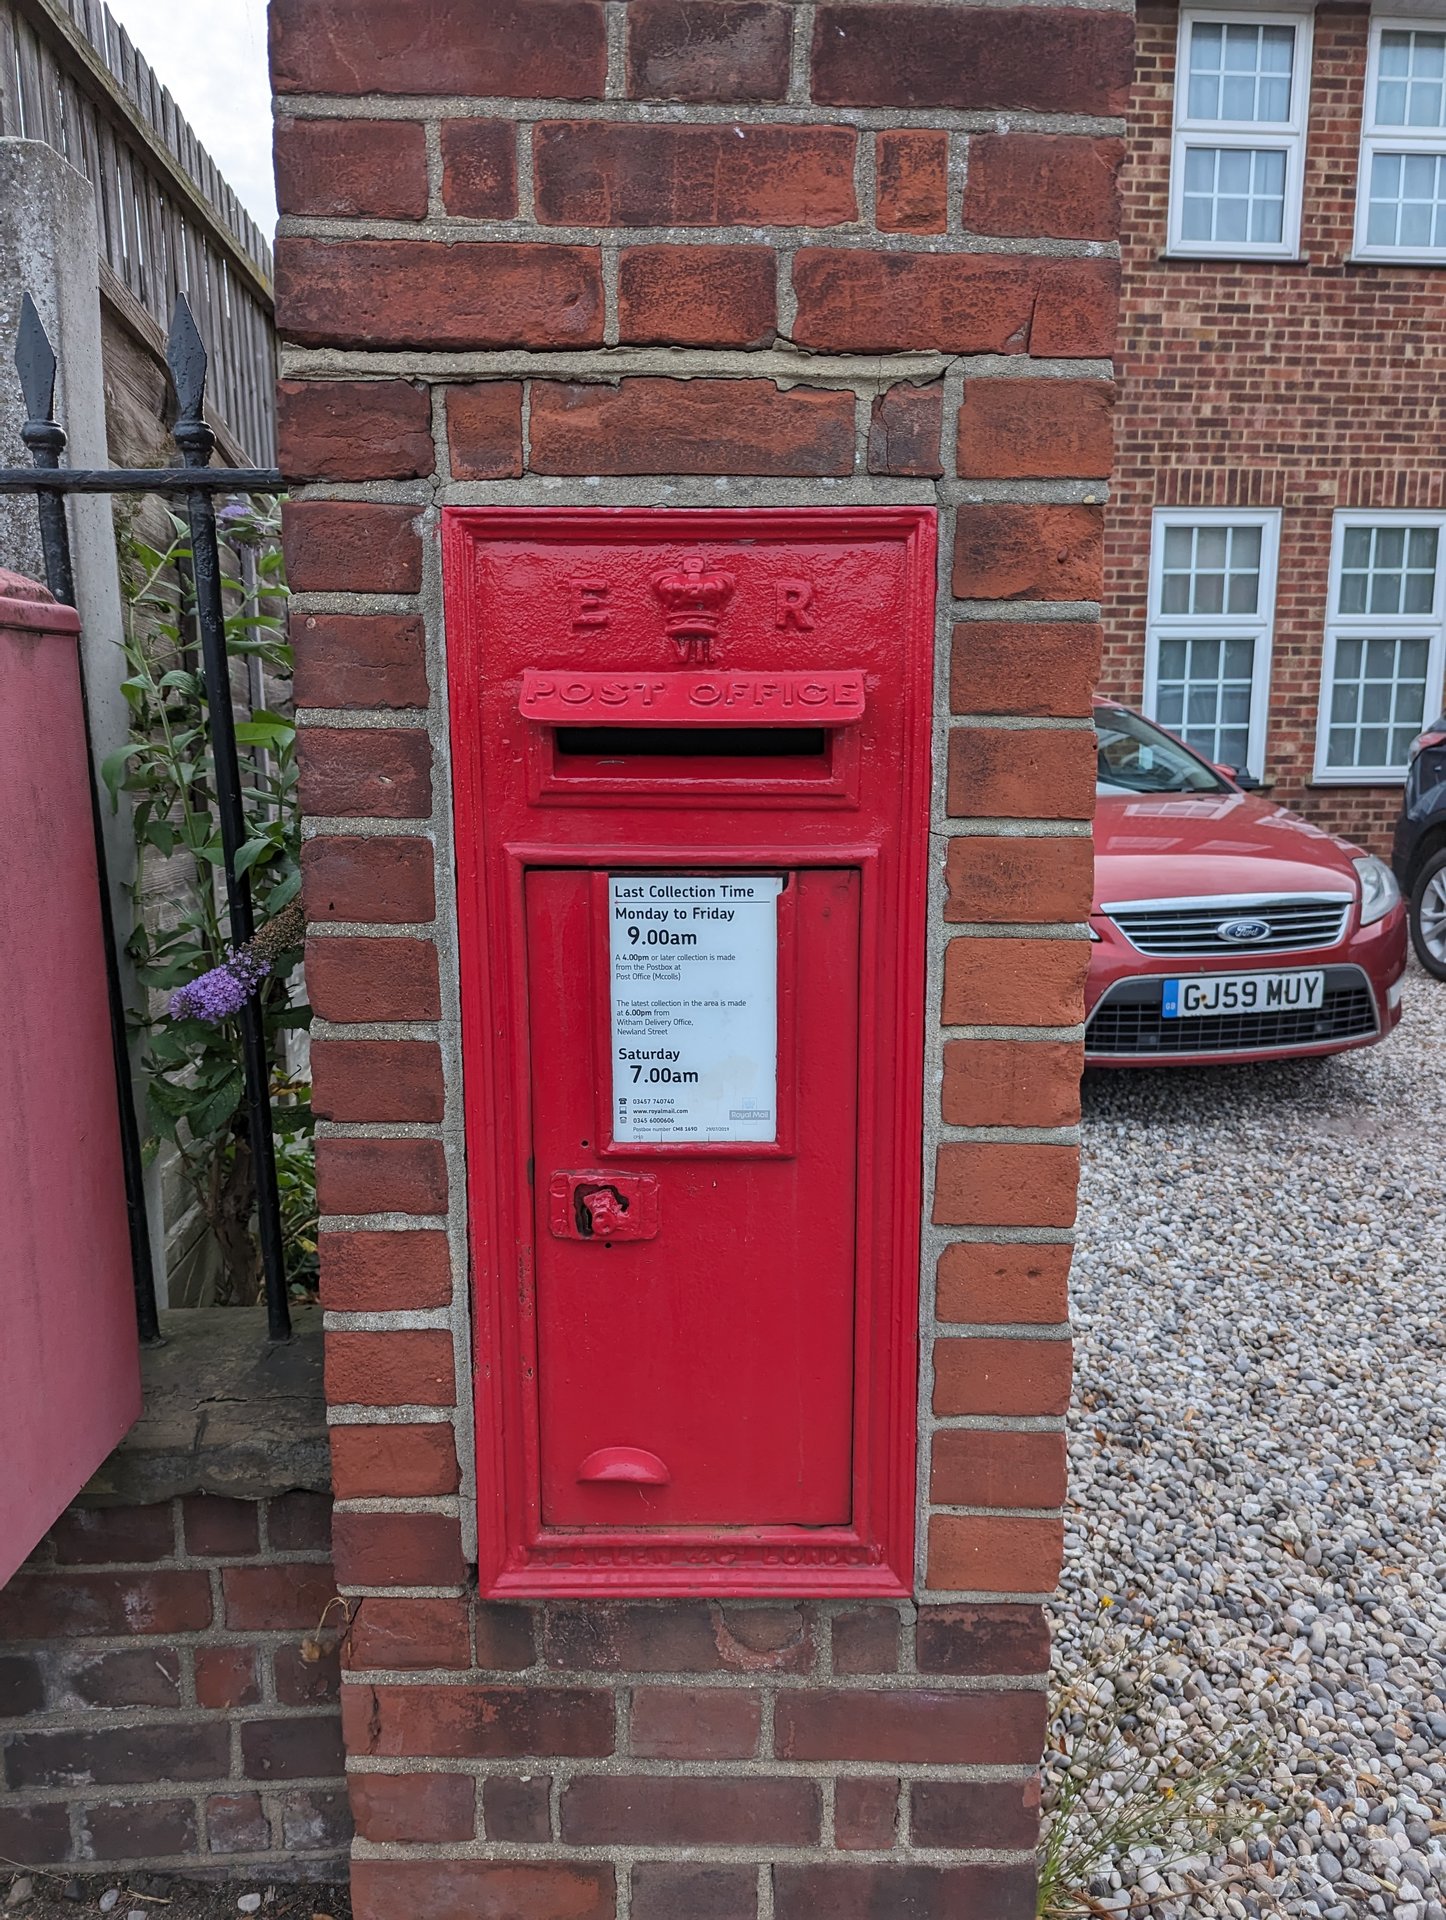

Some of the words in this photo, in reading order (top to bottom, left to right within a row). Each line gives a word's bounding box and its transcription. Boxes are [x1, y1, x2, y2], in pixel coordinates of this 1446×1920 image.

[571, 577, 609, 631] E
[774, 579, 815, 632] R
[525, 678, 664, 706] POST
[688, 680, 861, 707] OFFICE
[615, 886, 645, 898] Last
[650, 885, 716, 898] Collection
[720, 885, 755, 898] Time
[615, 907, 669, 922] Monday
[673, 908, 687, 920] to
[693, 907, 735, 922] Friday
[627, 926, 697, 945] 9.00am
[1235, 924, 1259, 938] Ford
[622, 954, 649, 963] 4.00pm
[646, 963, 673, 971] Postbox
[652, 973, 681, 981] (Mccolls)
[1183, 980, 1258, 1011] GJ59
[1265, 975, 1320, 1006] MUY
[1165, 1001, 1176, 1011] GB
[625, 1009, 652, 1017] 6.00pm
[645, 1018, 672, 1027] Delivery
[618, 1048, 680, 1062] Saturday
[630, 1065, 699, 1083] 7.00am
[731, 1111, 751, 1119] Royal
[752, 1111, 769, 1119] Mail
